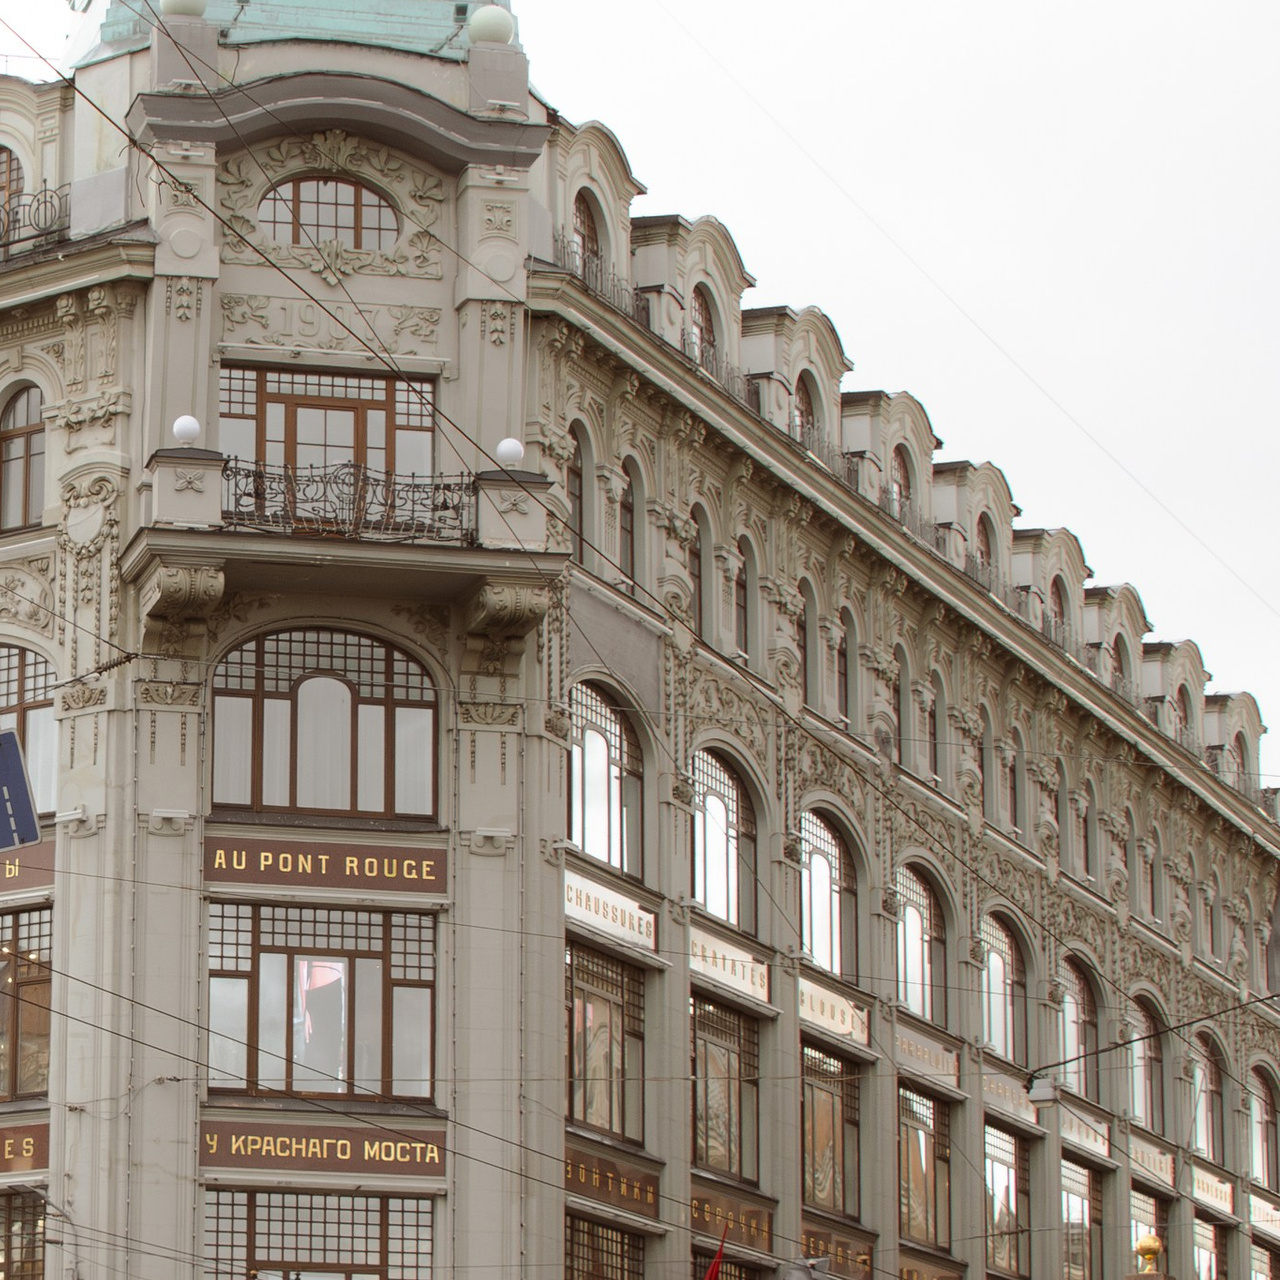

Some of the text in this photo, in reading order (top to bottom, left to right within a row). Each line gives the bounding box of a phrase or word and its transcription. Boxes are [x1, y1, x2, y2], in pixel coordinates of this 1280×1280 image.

[214, 849, 436, 880] AU PONT ROUGE
[566, 883, 652, 939] CHAUSSURES
[206, 1133, 440, 1164] У КРАСНАГО МОСТА
